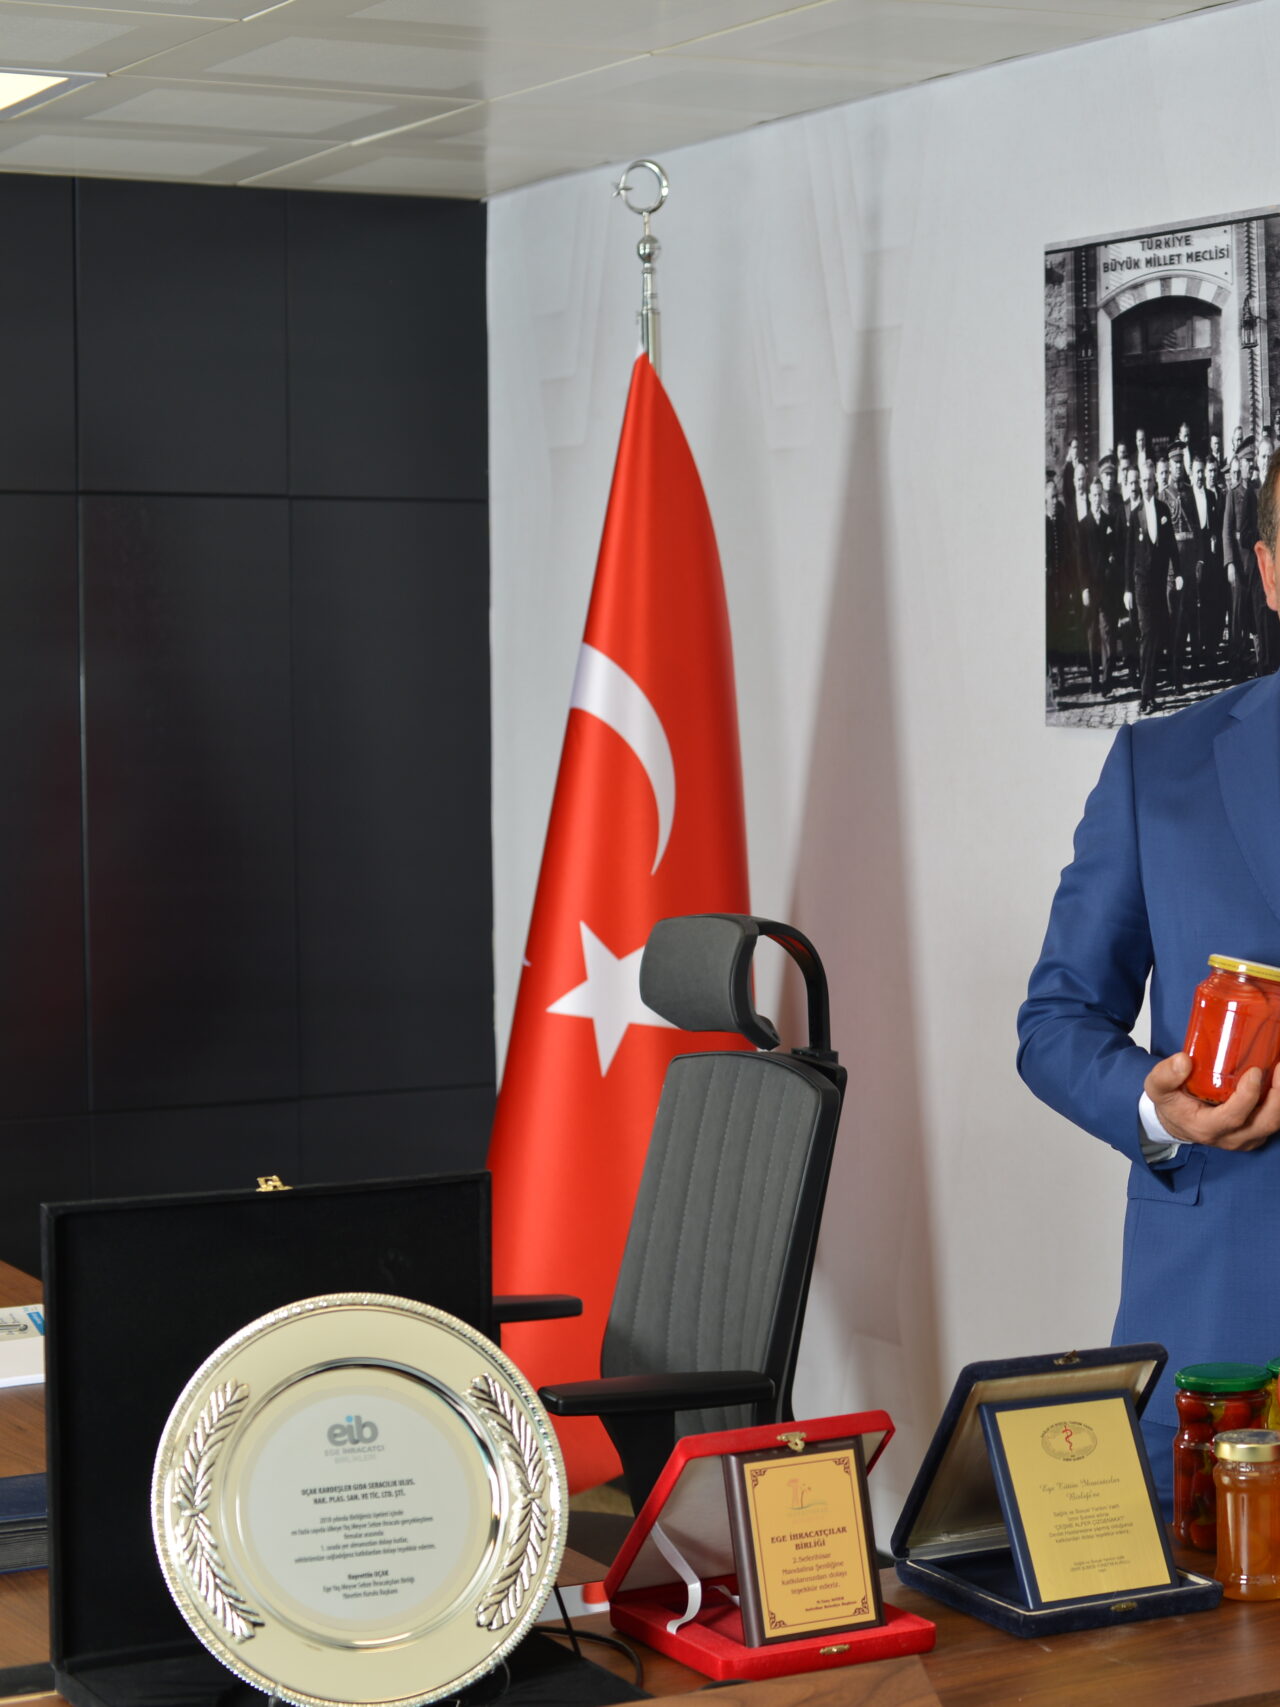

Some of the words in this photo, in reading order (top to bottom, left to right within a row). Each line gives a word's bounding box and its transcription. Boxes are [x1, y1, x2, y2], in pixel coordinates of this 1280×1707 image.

[1140, 233, 1192, 251] TÜRKİYE
[1103, 256, 1140, 273] BÜYÜK
[1145, 253, 1182, 268] MİLLET
[1186, 244, 1230, 263] MECLİSİ
[326, 1415, 379, 1447] eib
[771, 1534, 787, 1544] EGE
